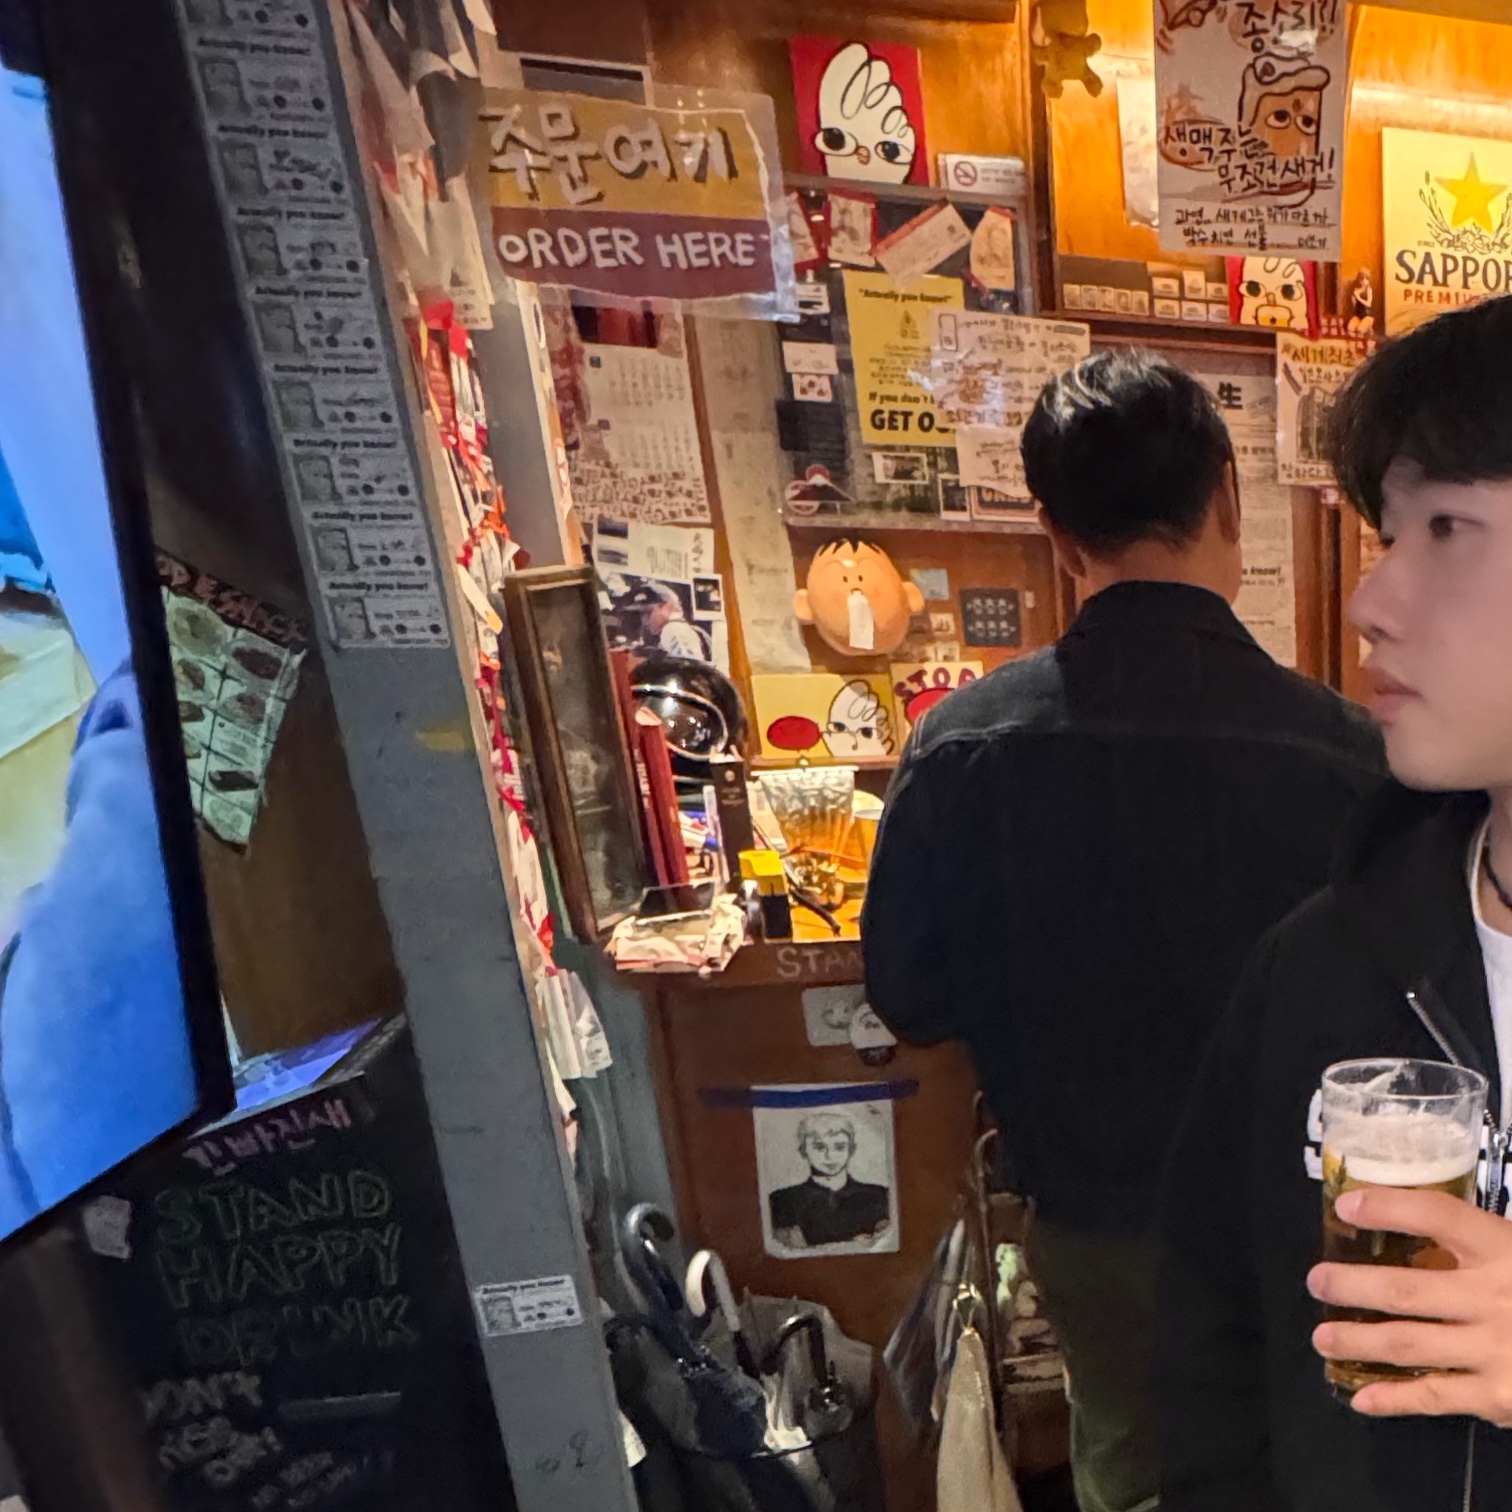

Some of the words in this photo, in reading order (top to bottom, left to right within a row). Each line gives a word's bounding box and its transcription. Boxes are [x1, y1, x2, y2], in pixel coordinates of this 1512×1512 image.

[1164, 123, 1269, 166] 생맥주는
[497, 225, 644, 270] ORDER
[655, 231, 756, 270] HERE
[870, 408, 913, 432] GET
[879, 394, 898, 405] you
[775, 946, 863, 979] STAN
[154, 1167, 391, 1248] STAND
[154, 1222, 403, 1311] HAPPY
